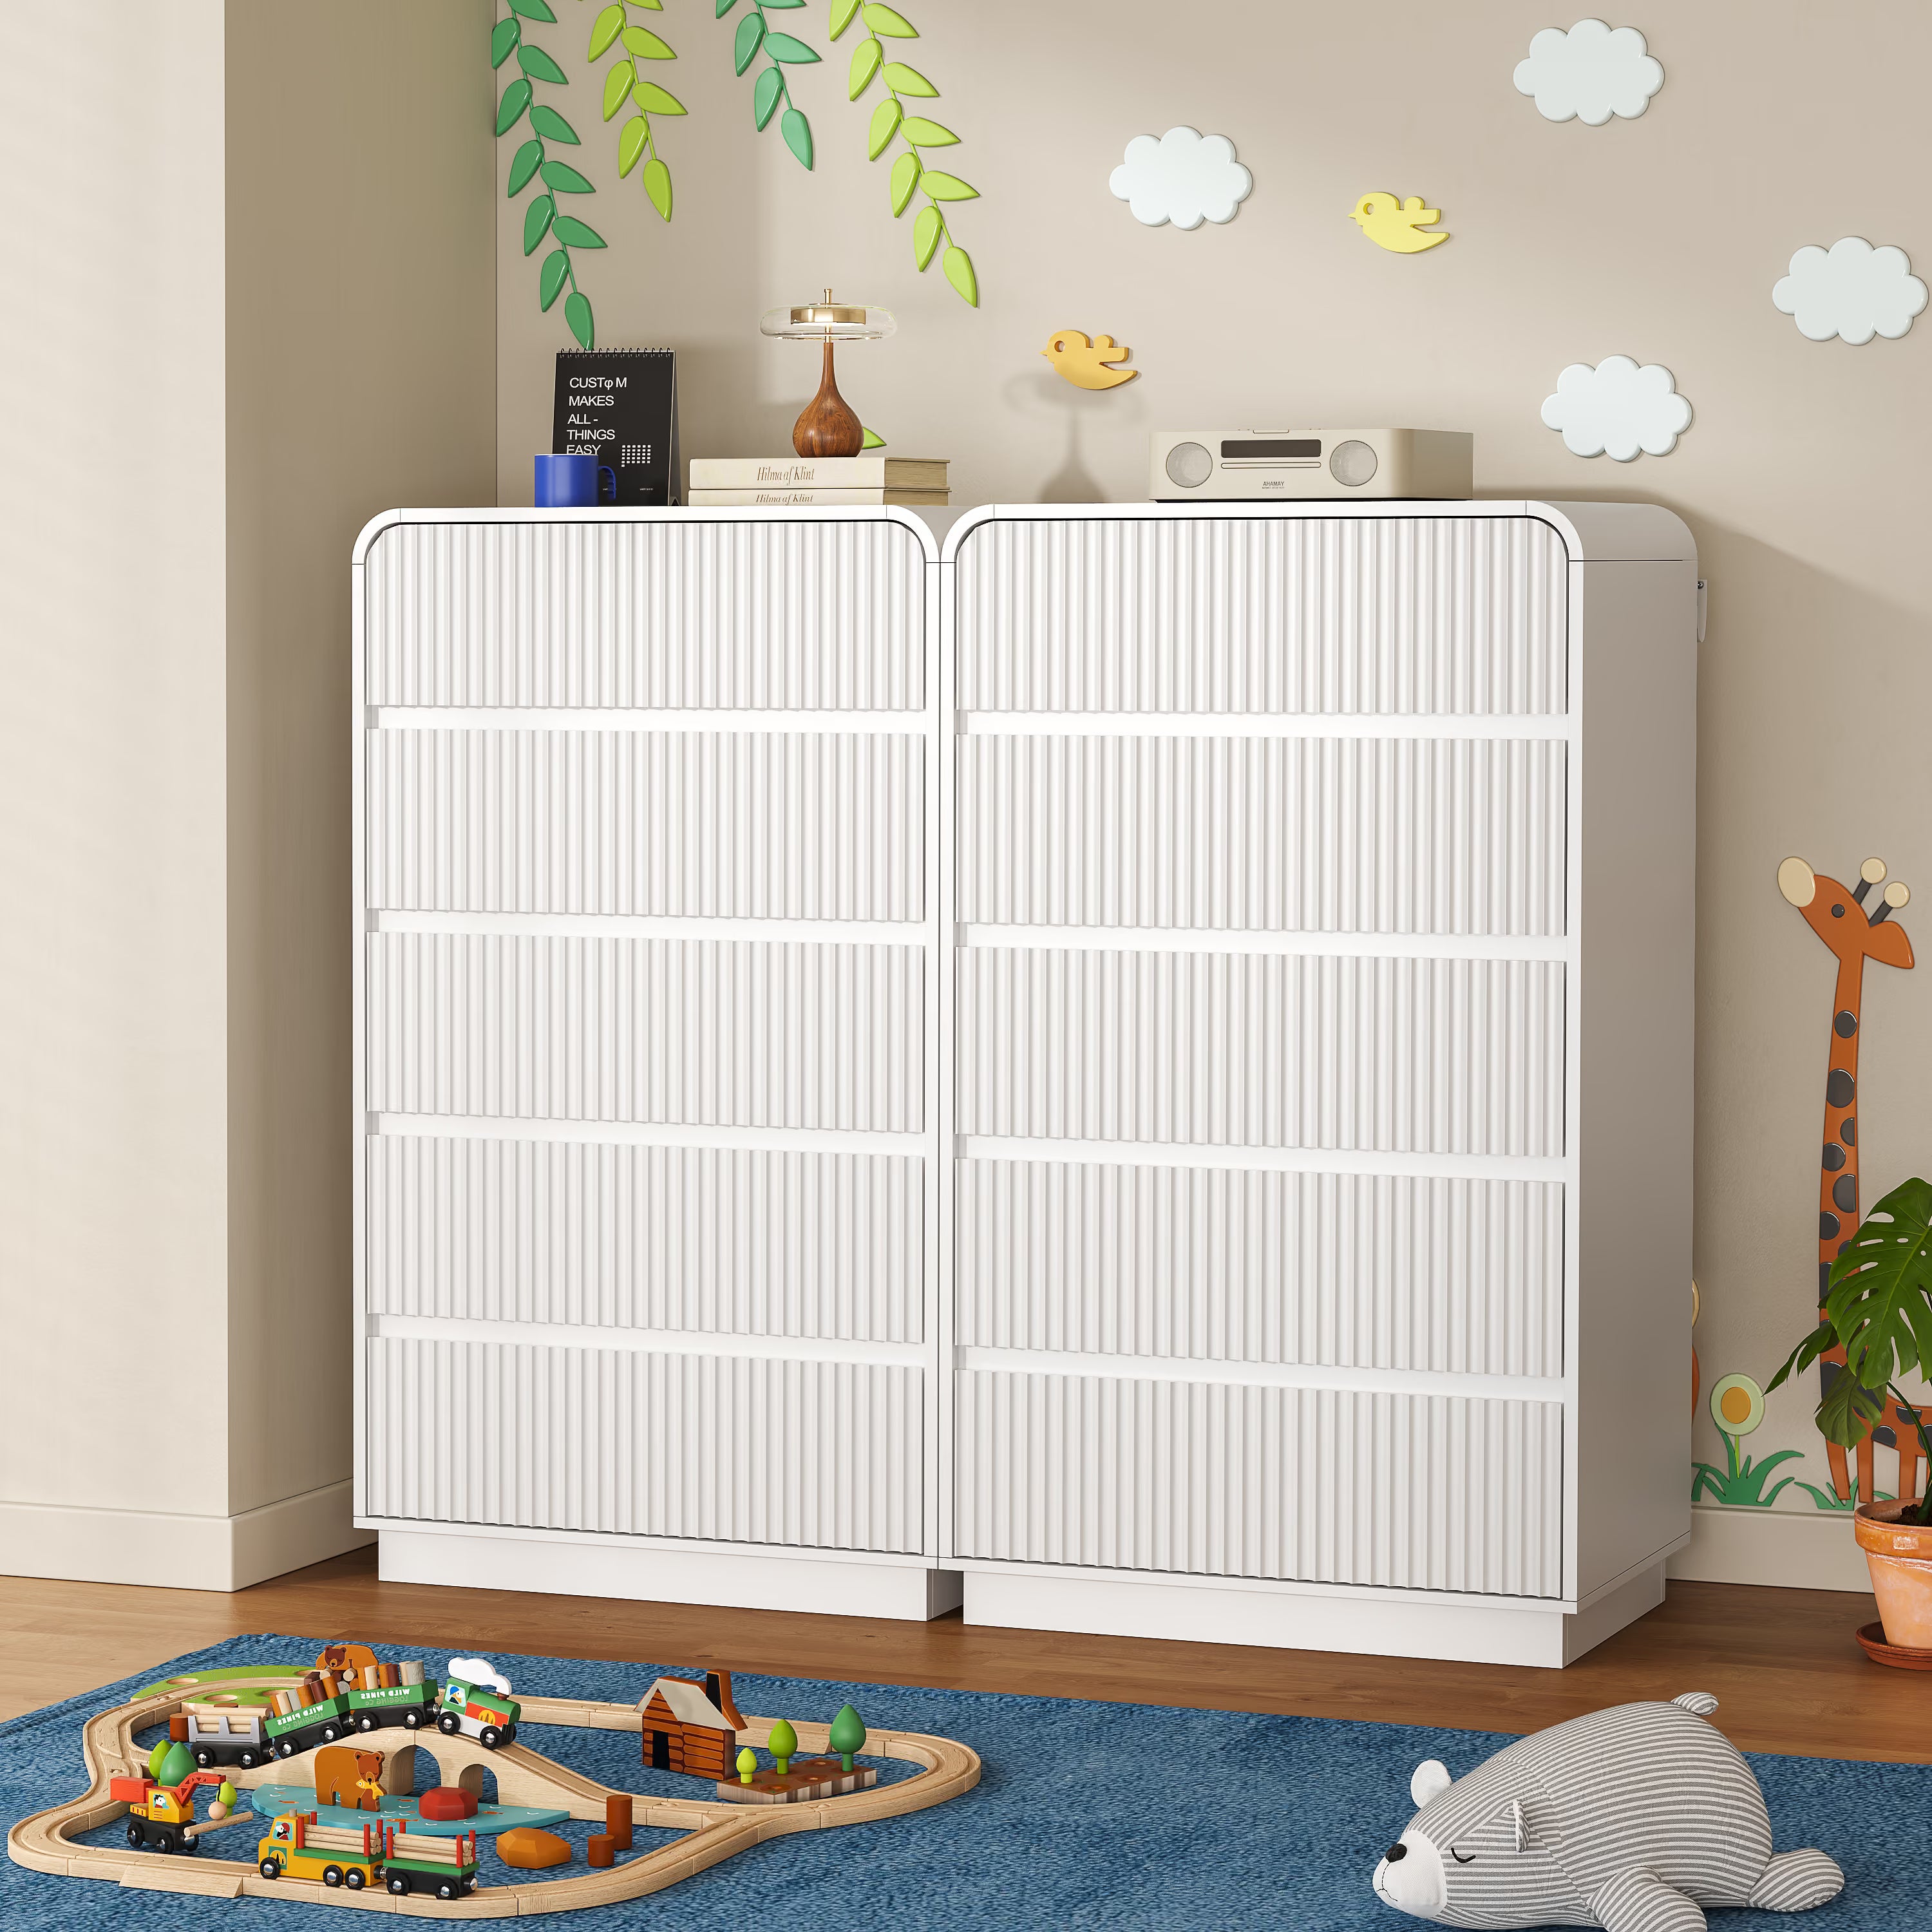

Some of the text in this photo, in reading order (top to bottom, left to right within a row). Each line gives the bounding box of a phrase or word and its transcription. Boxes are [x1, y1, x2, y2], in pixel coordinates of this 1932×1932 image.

[569, 395, 614, 406] MAKES
[567, 413, 591, 424] ALL
[567, 429, 616, 440] THINGS
[567, 444, 601, 455] EASY
[757, 466, 815, 486] Hilma af Klint
[755, 494, 781, 503] Hilma
[793, 493, 813, 502] Klint
